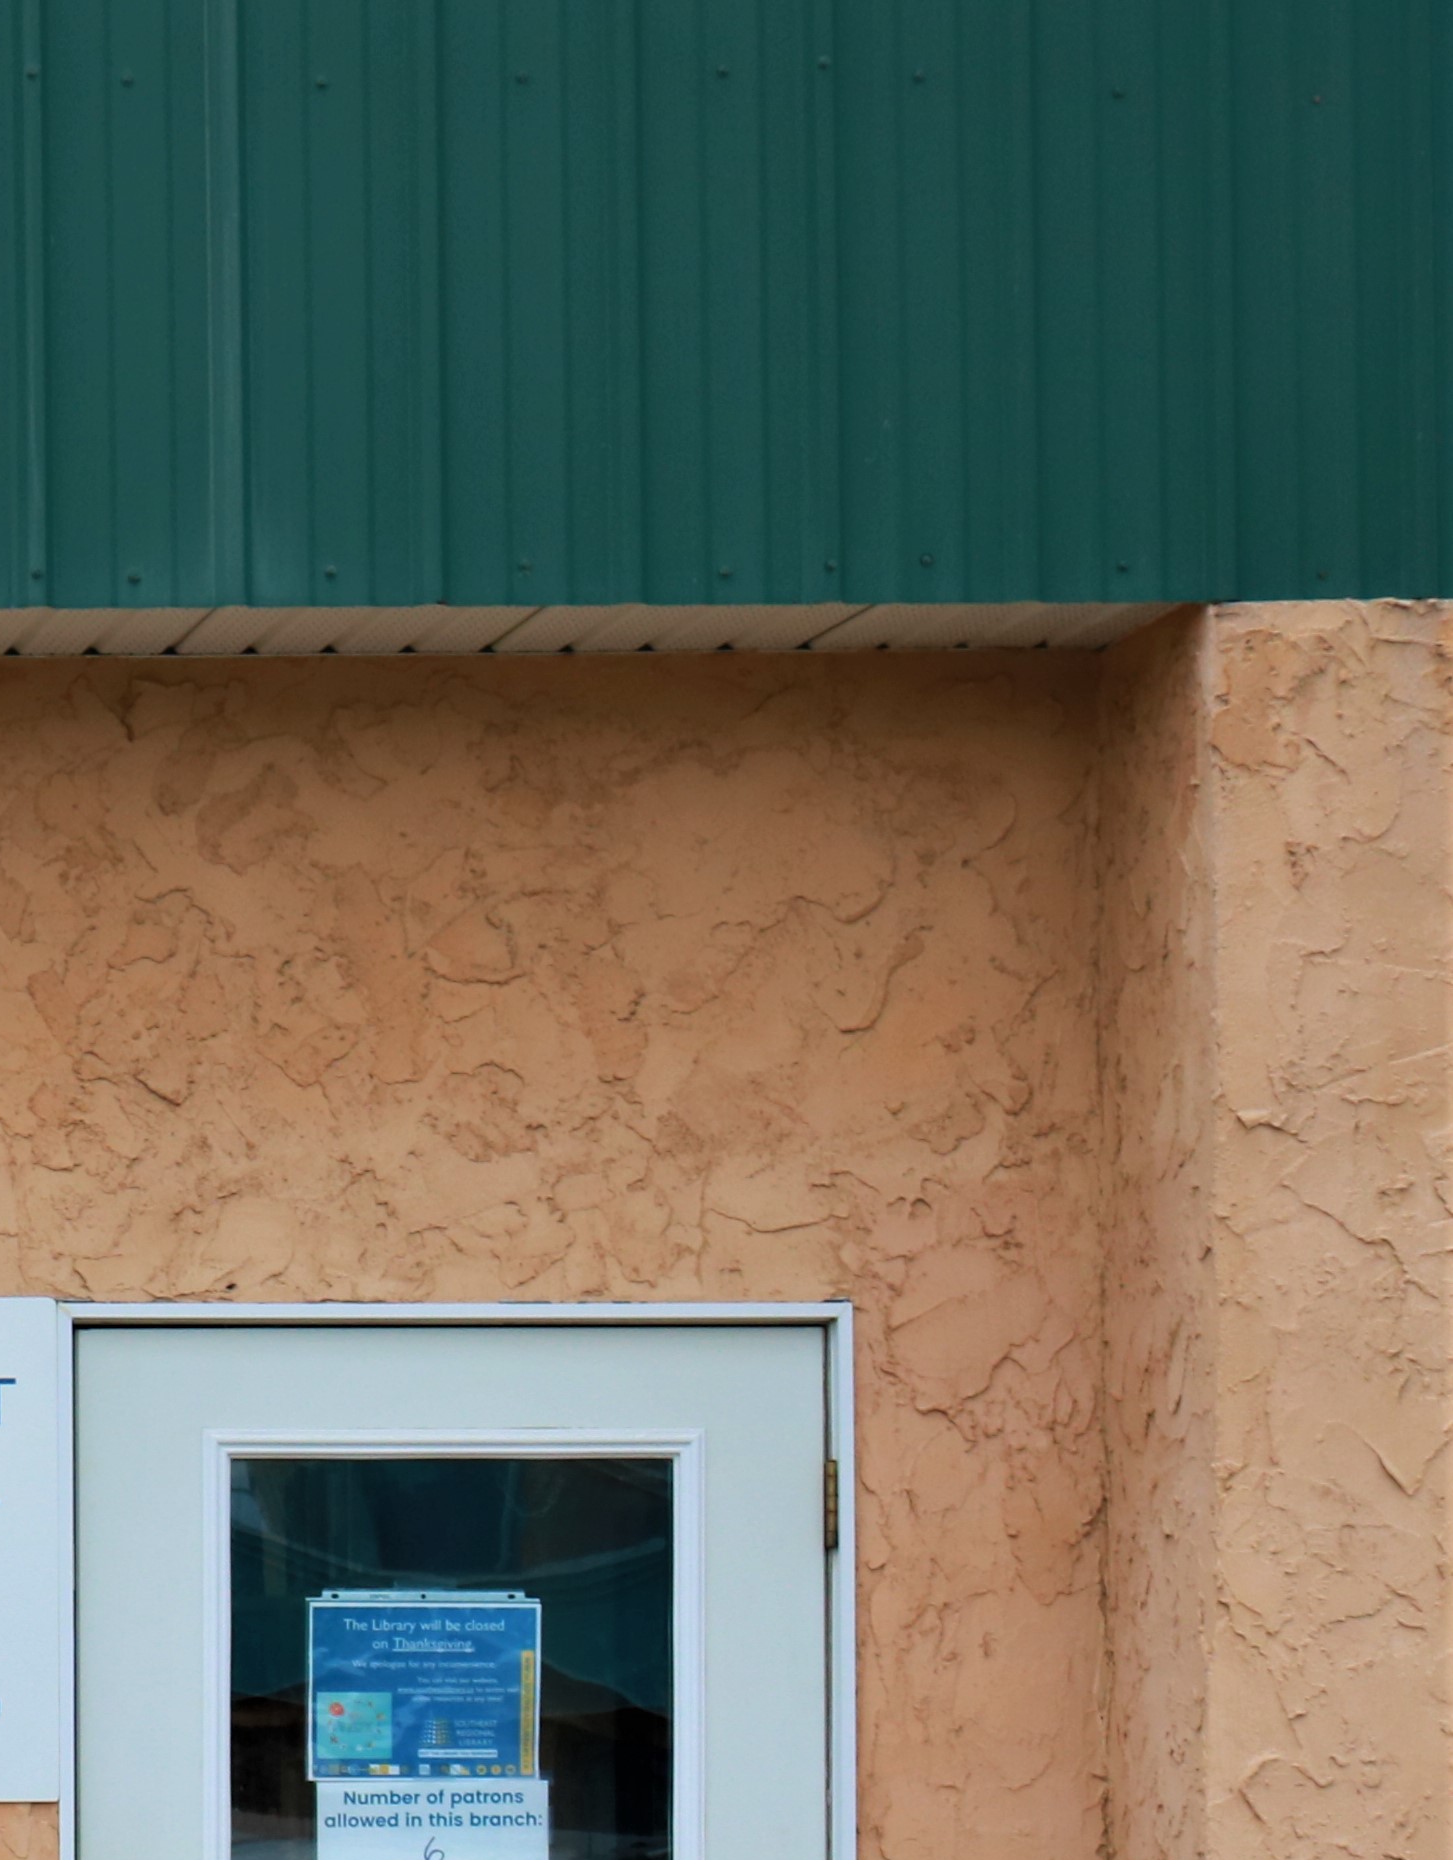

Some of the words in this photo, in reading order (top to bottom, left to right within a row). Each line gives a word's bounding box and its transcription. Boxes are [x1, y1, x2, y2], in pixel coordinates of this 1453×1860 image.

[344, 1619, 368, 1631] The
[372, 1619, 416, 1633] Library
[420, 1619, 441, 1631] will
[445, 1619, 461, 1631] be
[465, 1619, 504, 1631] closed
[373, 1641, 388, 1649] on
[343, 1790, 420, 1805] Number
[427, 1790, 444, 1804] of
[451, 1791, 524, 1808] patrons
[324, 1813, 399, 1828] allowed
[406, 1813, 422, 1827] in
[429, 1813, 462, 1827] this
[470, 1813, 542, 1827] branch:
